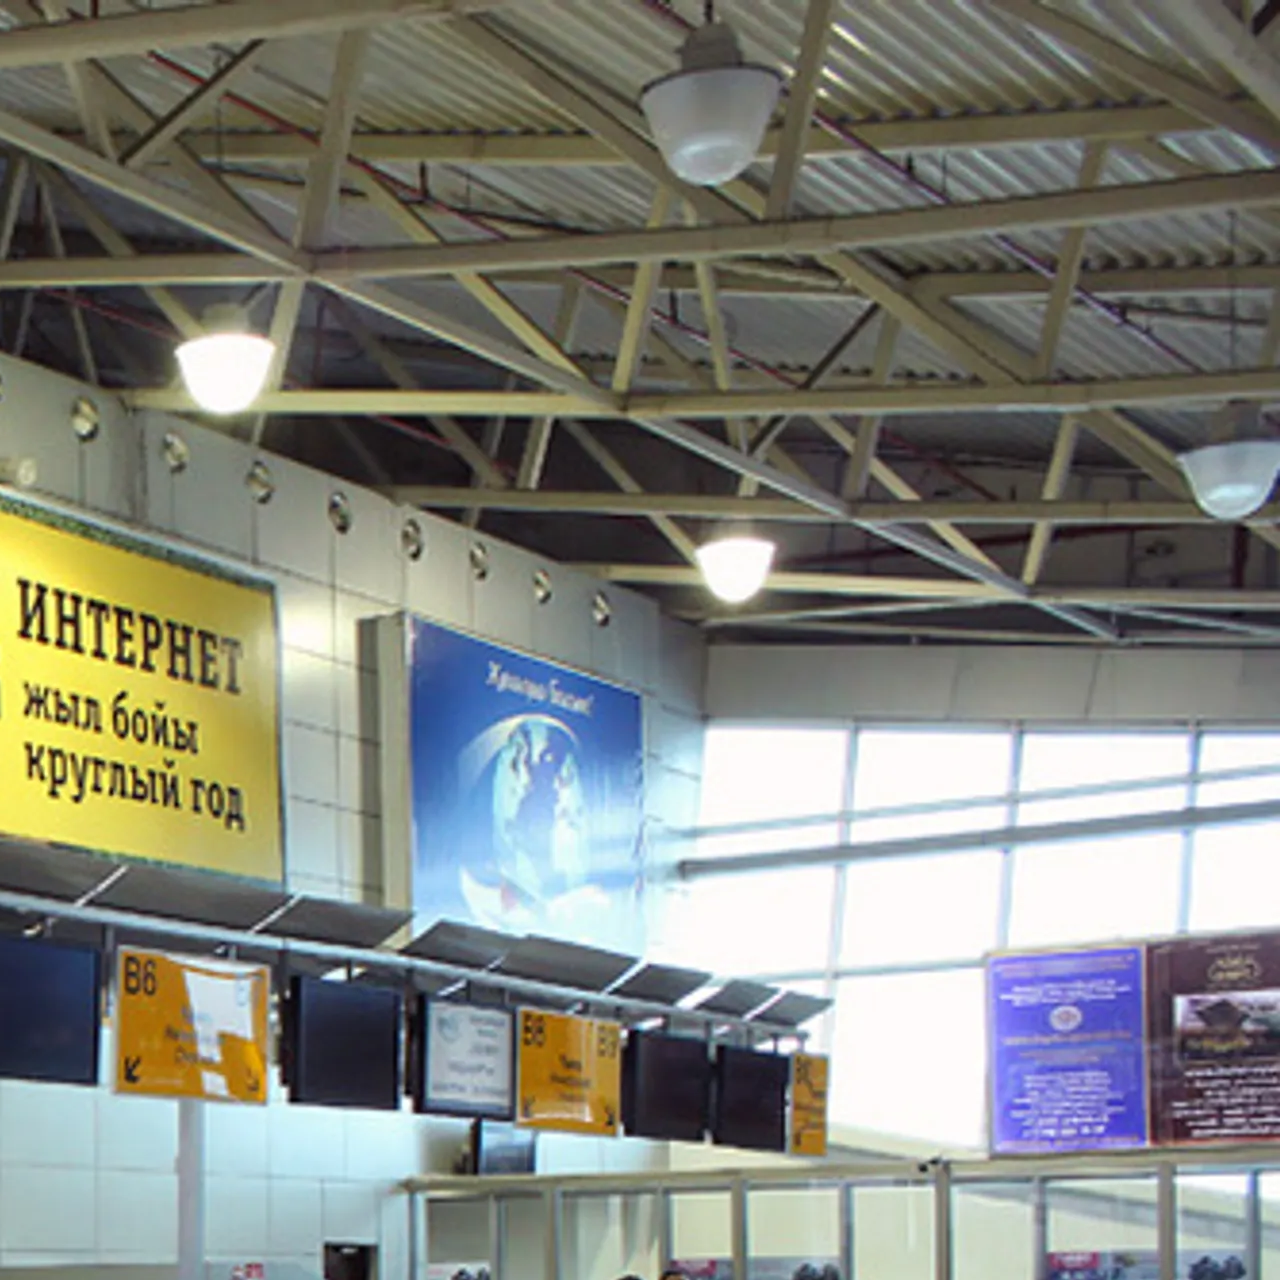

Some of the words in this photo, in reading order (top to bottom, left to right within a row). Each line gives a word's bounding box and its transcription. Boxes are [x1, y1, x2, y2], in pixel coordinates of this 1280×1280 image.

[16, 578, 243, 696] ИНТЕРНЕТ
[23, 681, 103, 734] жыл
[112, 690, 200, 755] бойы
[24, 742, 181, 810] круглый
[190, 780, 246, 832] год
[124, 955, 158, 997] B6
